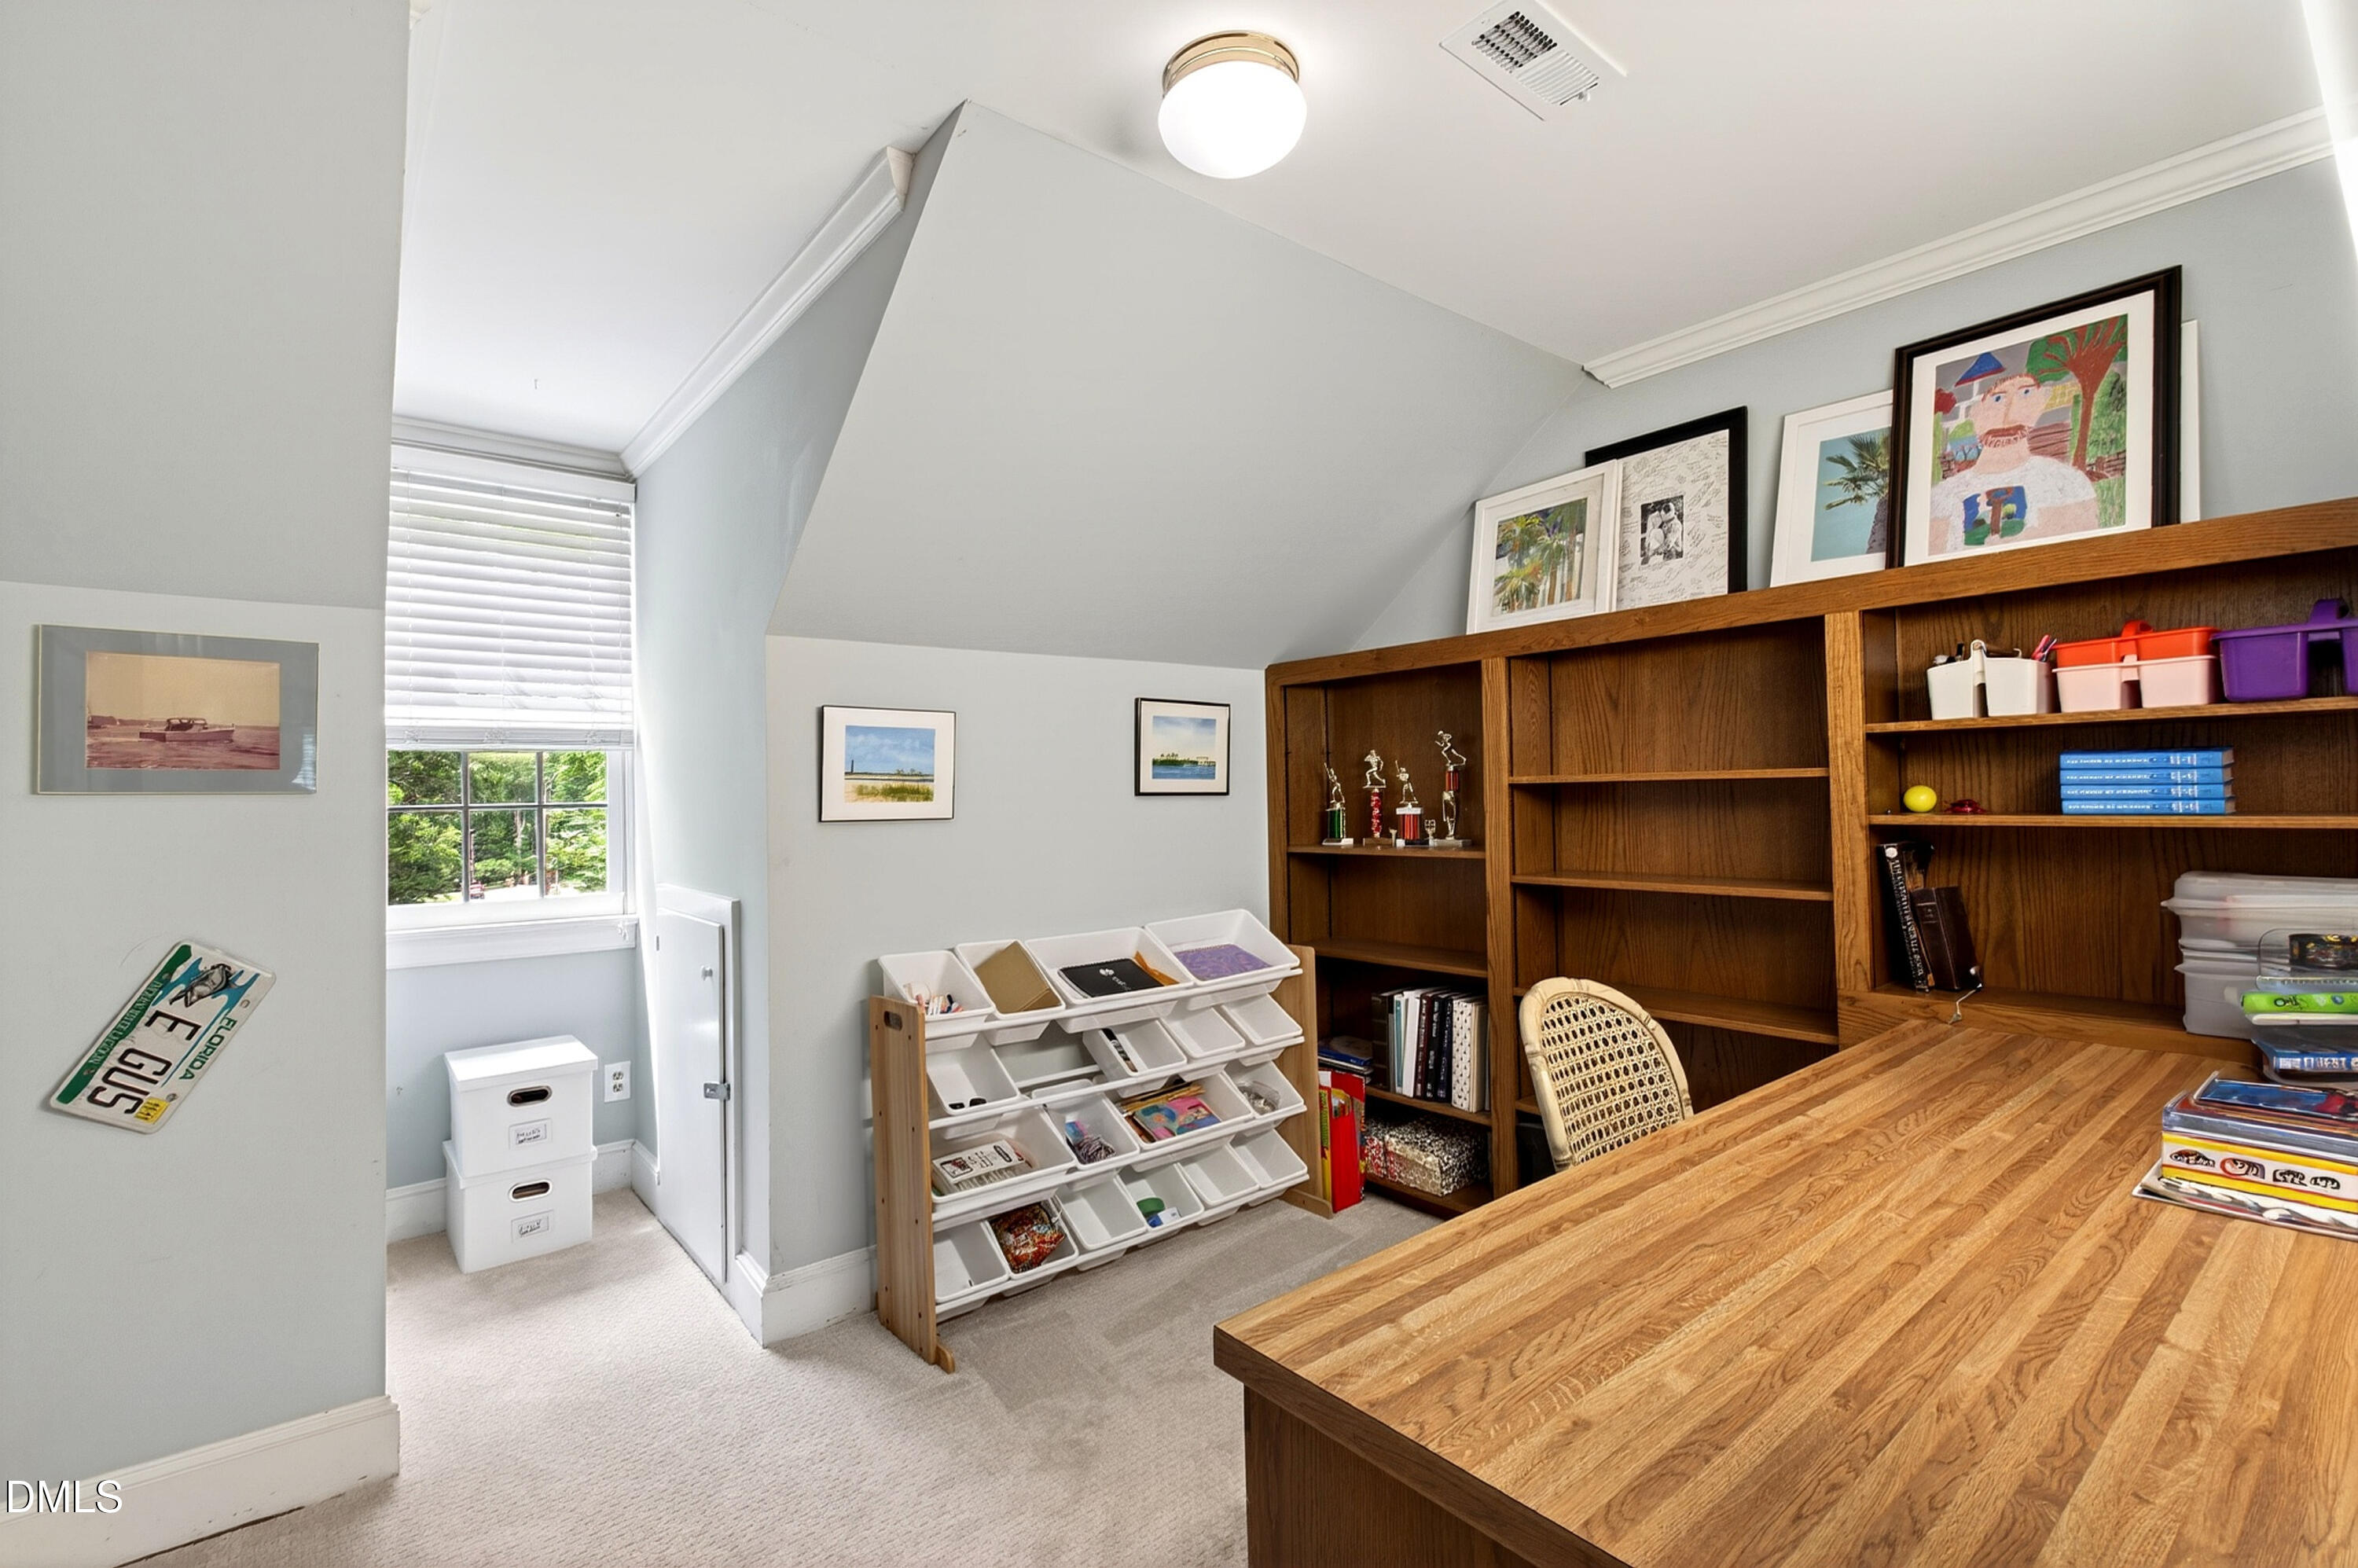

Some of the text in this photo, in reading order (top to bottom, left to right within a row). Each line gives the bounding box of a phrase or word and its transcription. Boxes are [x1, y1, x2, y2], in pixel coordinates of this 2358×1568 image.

[145, 1010, 202, 1041] E
[179, 1016, 237, 1080] FLORIDA
[86, 1048, 172, 1114] GUS
